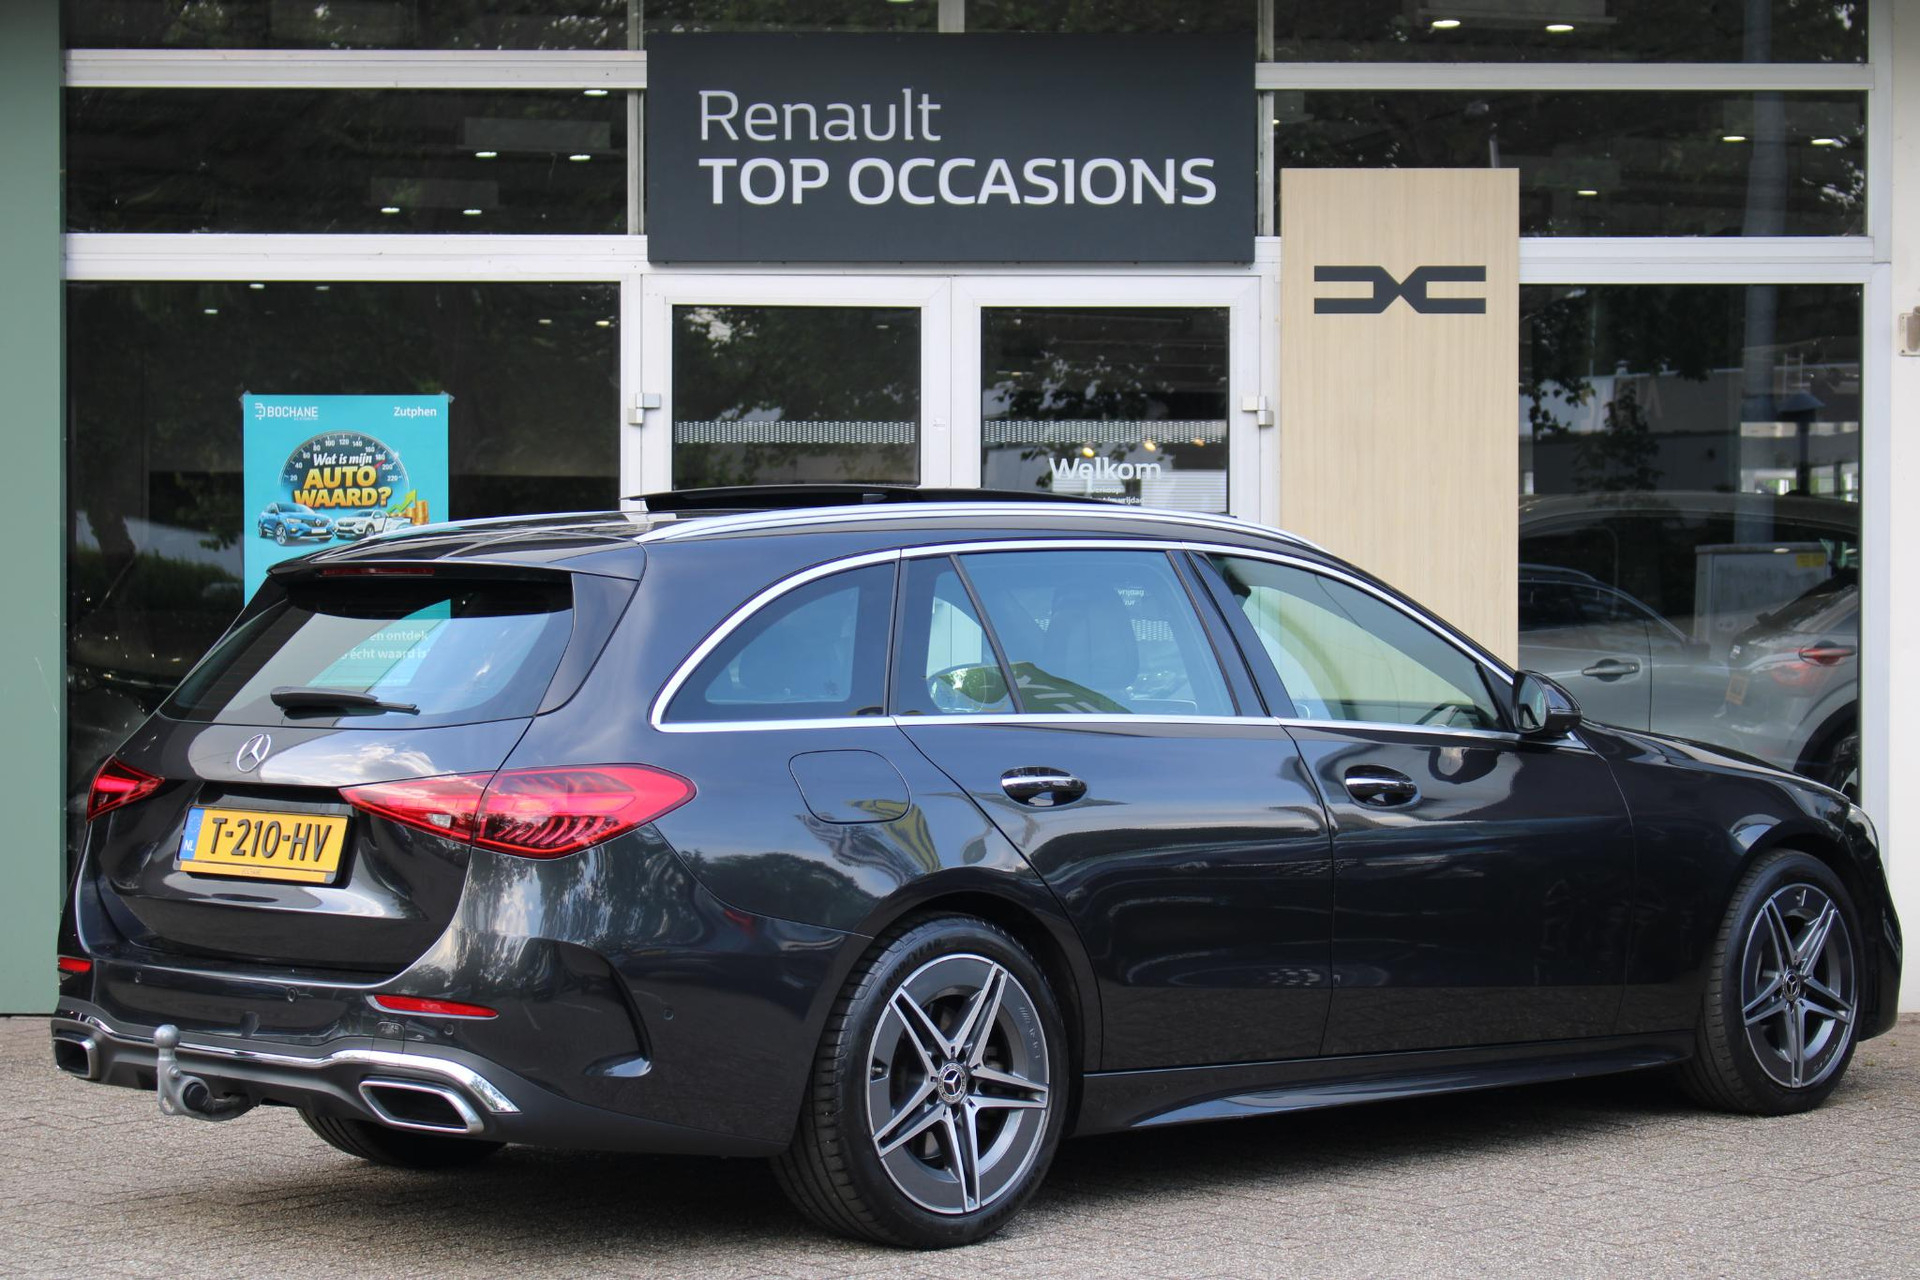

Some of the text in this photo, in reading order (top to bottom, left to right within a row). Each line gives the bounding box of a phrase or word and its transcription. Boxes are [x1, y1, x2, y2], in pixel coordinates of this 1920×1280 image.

[699, 88, 941, 142] Renault
[698, 157, 1217, 206] TOP OCCASIONS
[267, 406, 319, 418] BOCHANE
[393, 406, 437, 418] Zutphen
[313, 453, 372, 466] Wat is mijn
[1048, 456, 1161, 480] Welkom
[303, 466, 377, 489] AUTO
[294, 487, 391, 507] WAARD?
[386, 630, 427, 641] ontdek
[377, 648, 415, 659] waard
[183, 839, 194, 852] NL
[210, 816, 332, 863] T-210-HV
